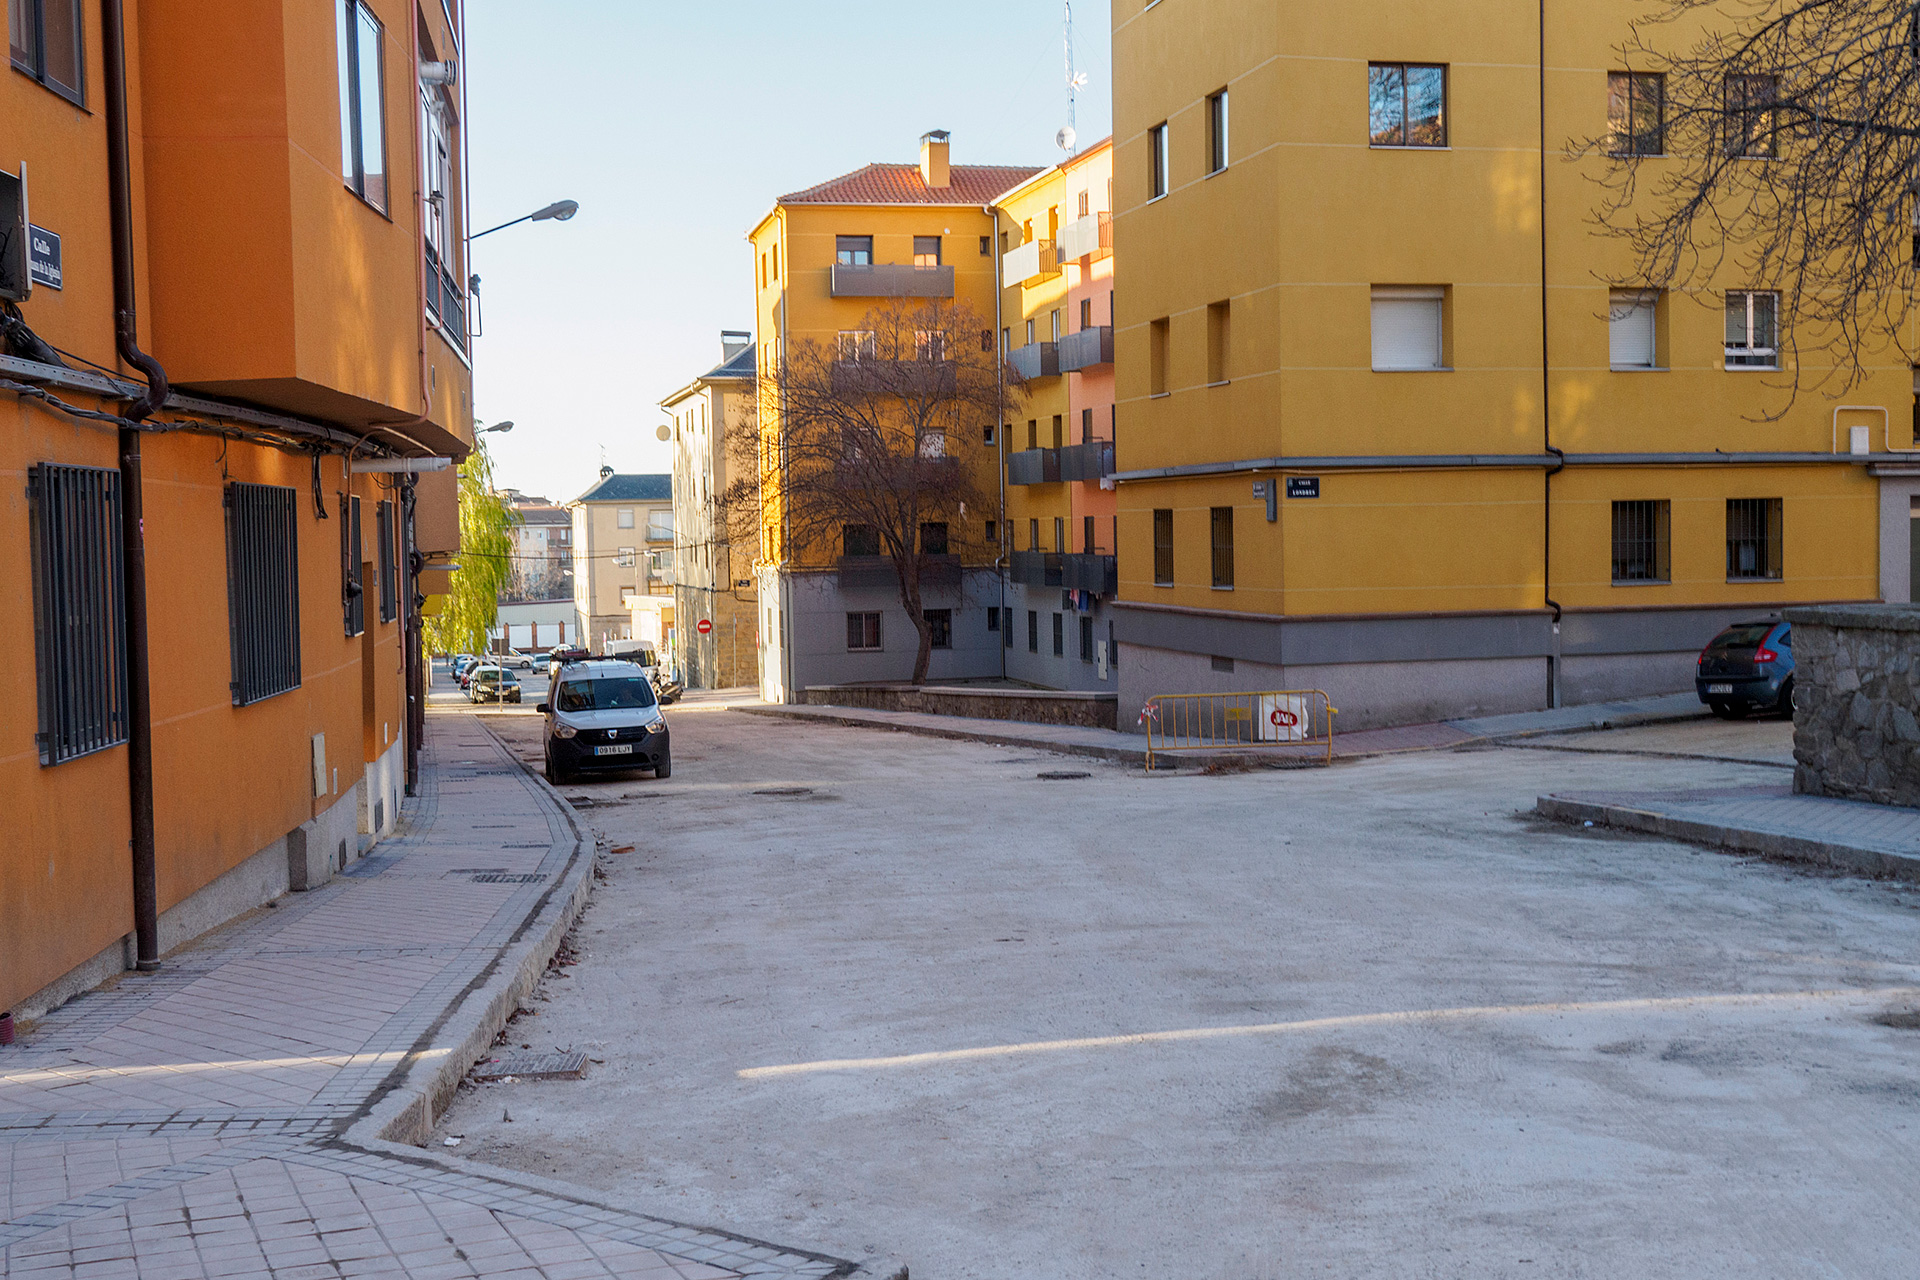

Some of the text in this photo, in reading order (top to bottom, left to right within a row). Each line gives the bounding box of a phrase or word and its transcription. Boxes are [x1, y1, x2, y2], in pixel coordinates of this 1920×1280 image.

[34, 237, 50, 256] Calle
[599, 745, 631, 755] 0916 LJY
